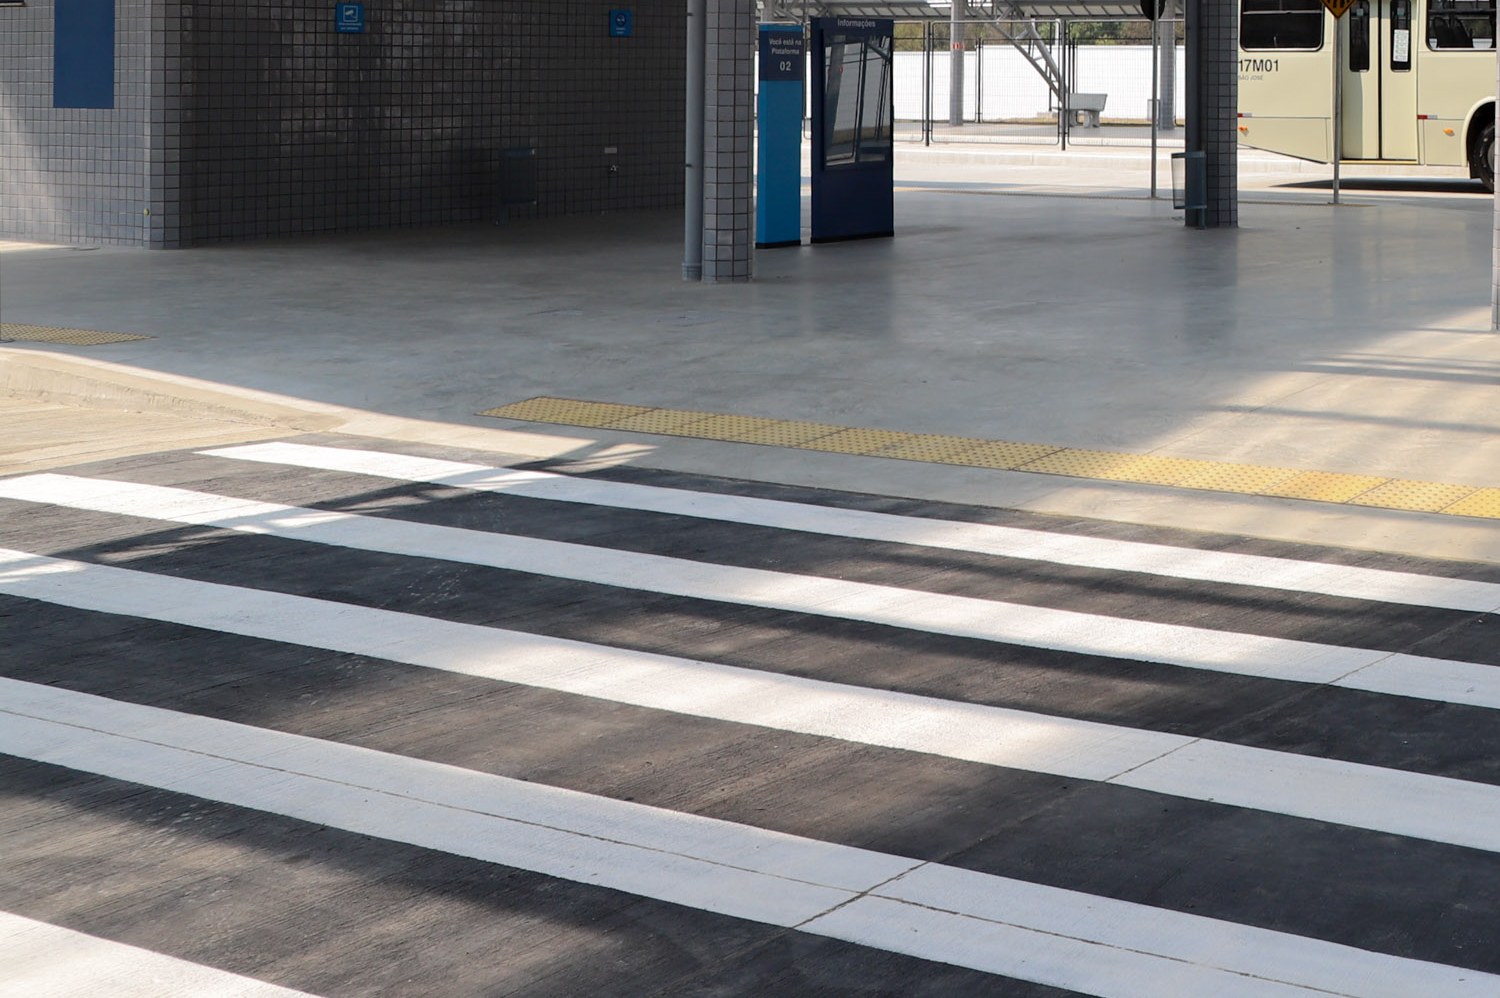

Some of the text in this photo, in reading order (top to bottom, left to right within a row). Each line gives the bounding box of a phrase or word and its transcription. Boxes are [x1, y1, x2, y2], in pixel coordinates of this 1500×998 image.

[837, 18, 876, 29] Informações
[769, 38, 782, 46] Você
[783, 38, 794, 46] está
[779, 61, 792, 72] 02
[1238, 59, 1279, 72] 17M01
